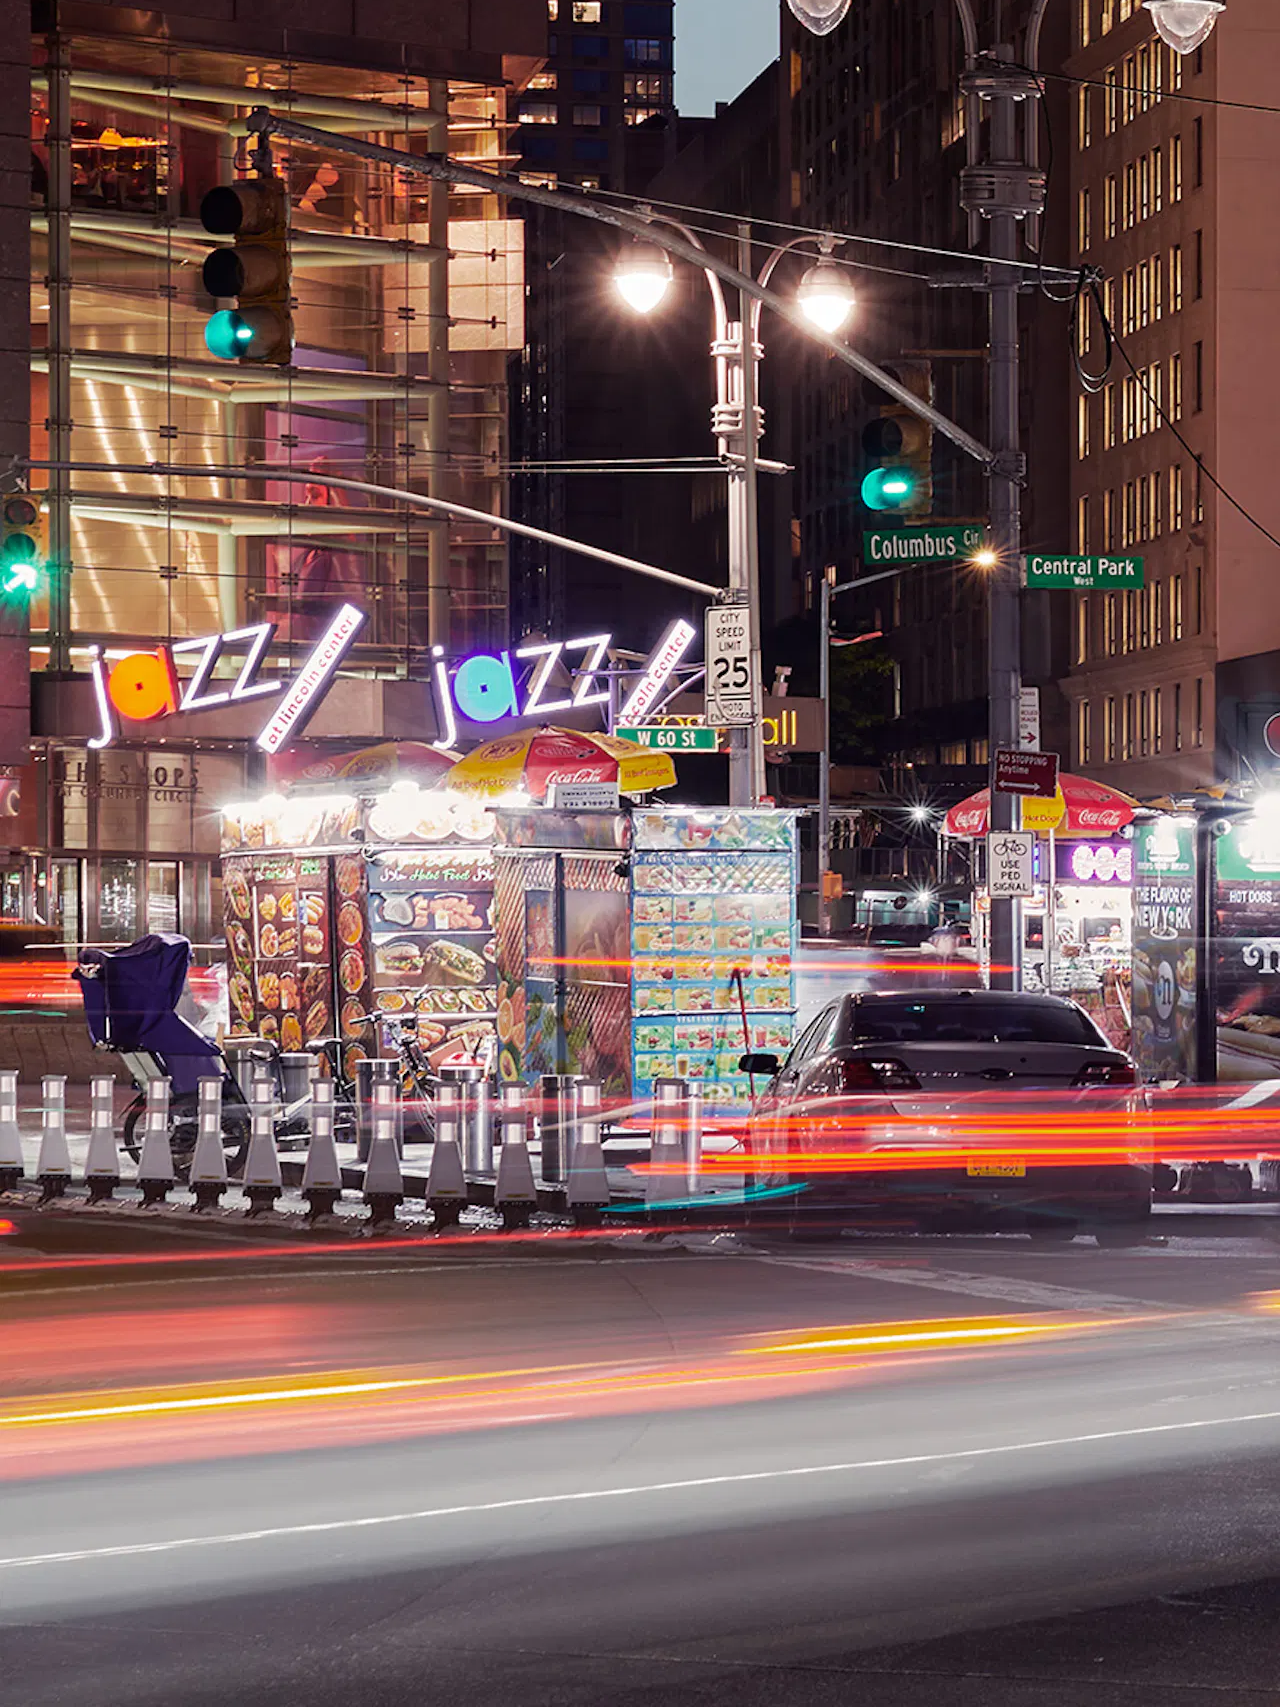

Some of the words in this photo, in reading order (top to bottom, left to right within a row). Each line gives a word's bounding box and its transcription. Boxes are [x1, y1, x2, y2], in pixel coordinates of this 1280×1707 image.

[870, 534, 957, 560] Columbus
[963, 530, 981, 546] Cir
[1031, 557, 1091, 575] Central
[1099, 558, 1135, 576] Park
[1073, 576, 1094, 586] West
[719, 613, 740, 624] CITY
[716, 627, 745, 638] SPEED
[653, 629, 688, 679] center
[719, 640, 742, 652] LIMIT
[714, 656, 749, 688] 25
[87, 622, 282, 749] jazz
[268, 726, 283, 745] at
[277, 670, 320, 723] lincoln
[317, 617, 353, 668] center
[432, 634, 612, 750] jazz
[761, 710, 797, 746] all
[637, 731, 651, 746] W
[657, 731, 677, 747] 60
[681, 731, 696, 747] St
[998, 754, 1010, 764] NO
[1011, 755, 1048, 767] STOPPING
[998, 765, 1030, 775] Anytime
[1025, 814, 1039, 823] Hot
[1078, 808, 1121, 826] Coca-Cola
[1000, 861, 1020, 870] USE
[1001, 871, 1021, 881] PED
[993, 882, 1029, 892] SIGNAL
[1135, 887, 1150, 903] THE
[1151, 887, 1180, 904] FLAVOR
[1180, 887, 1192, 904] OF
[1229, 890, 1249, 903] HOT
[1249, 890, 1273, 903] DOGS
[1135, 906, 1160, 928] NEW
